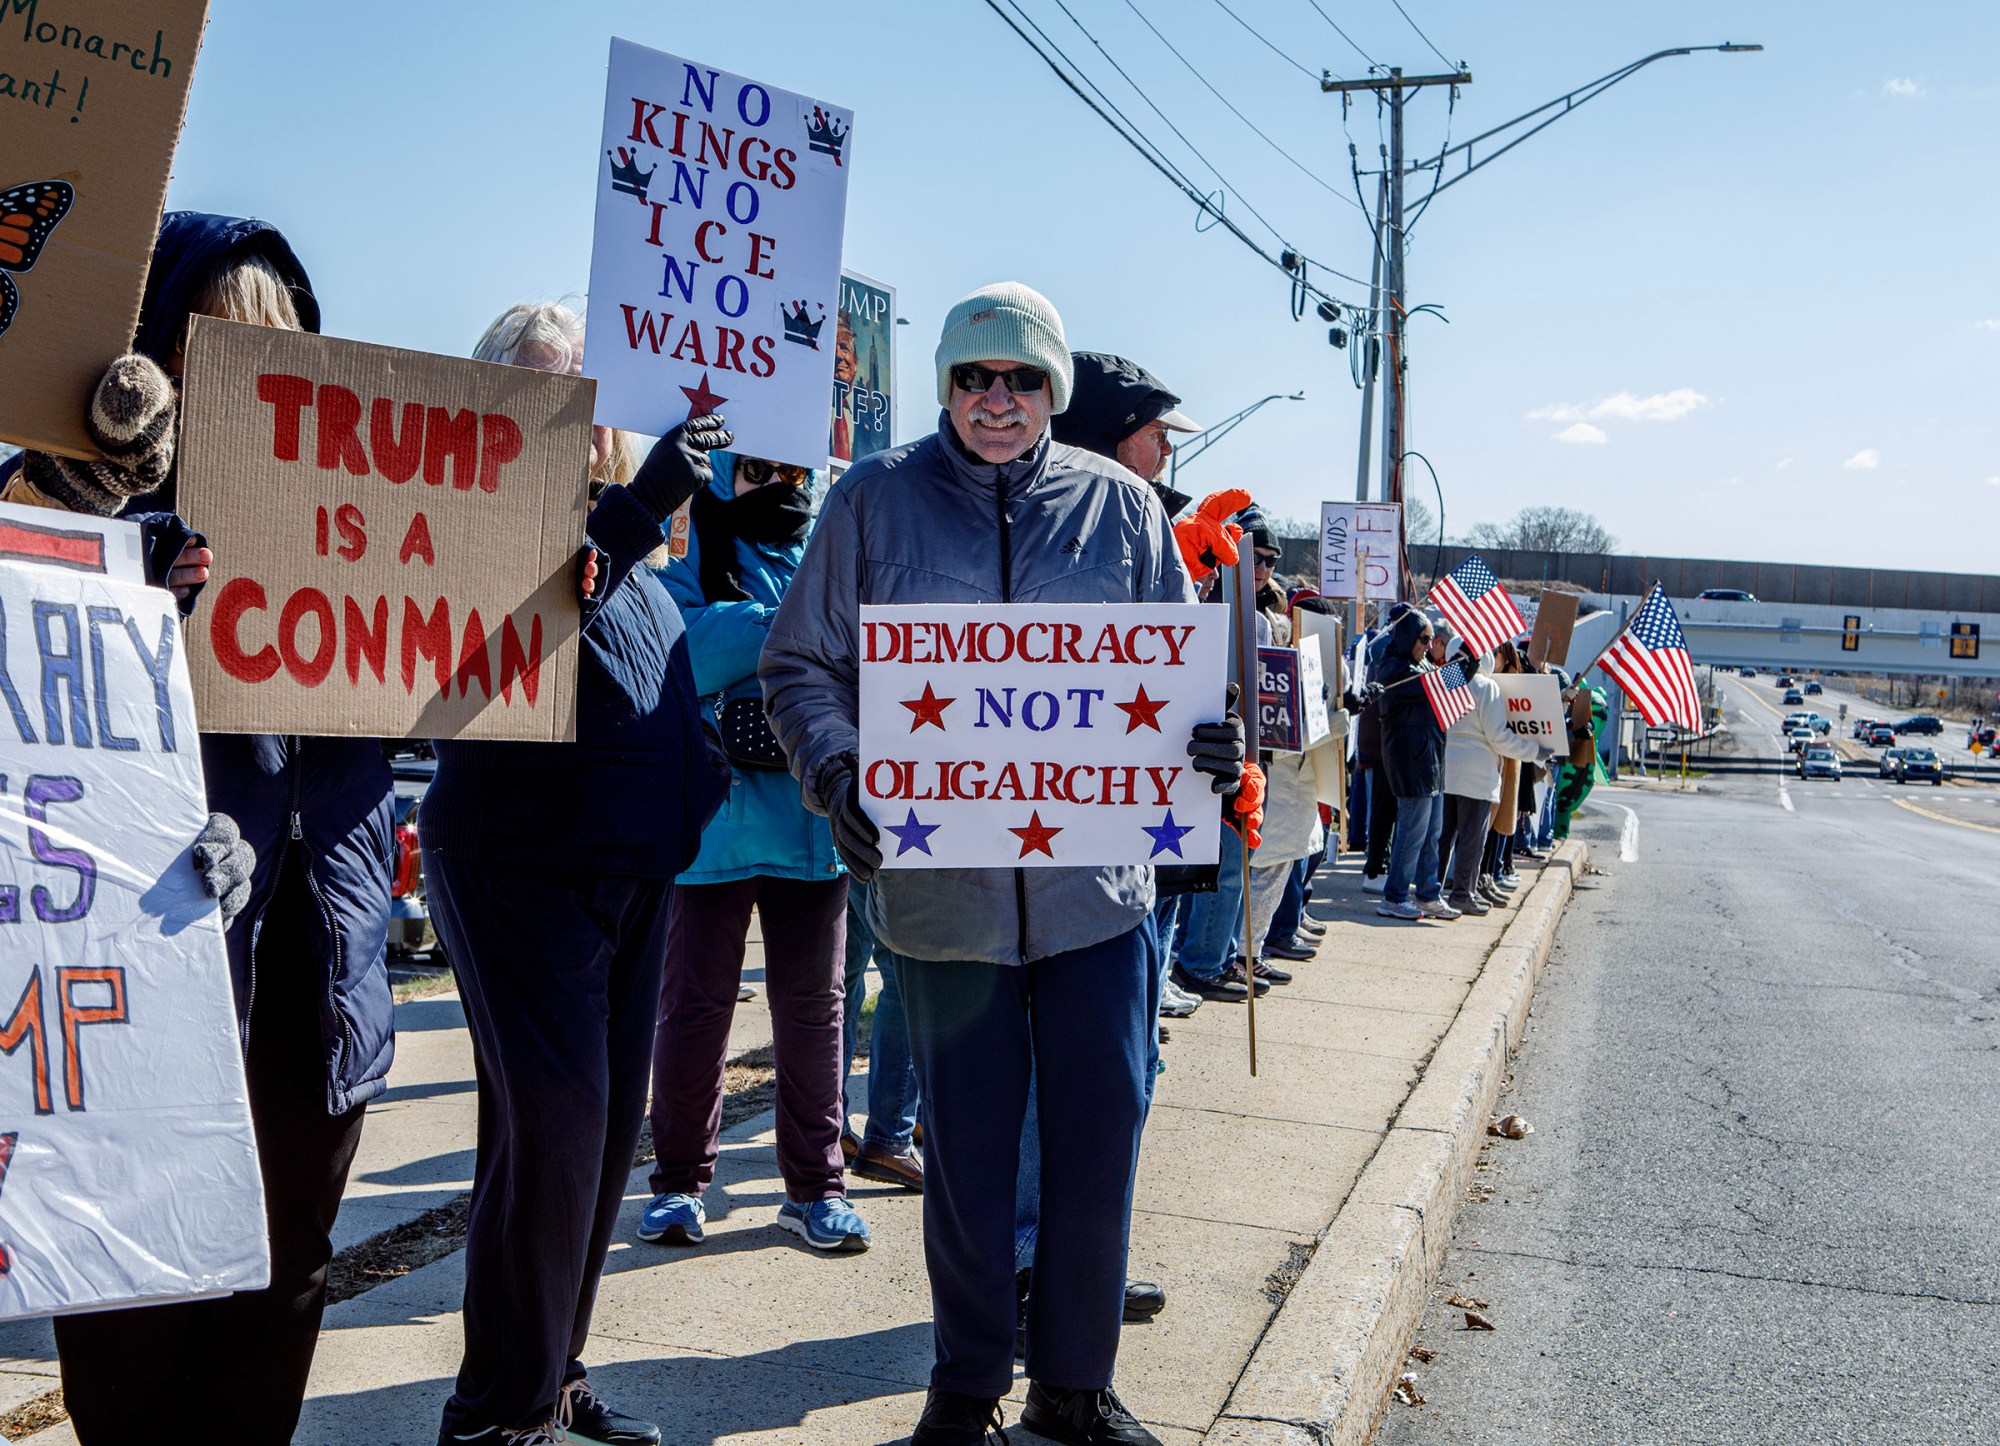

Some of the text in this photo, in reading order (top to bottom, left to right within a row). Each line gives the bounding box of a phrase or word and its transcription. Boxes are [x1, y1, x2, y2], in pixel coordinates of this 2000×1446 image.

[0, 0, 172, 77] Monarch
[680, 63, 771, 127] NO
[627, 97, 797, 190] KINGS
[668, 160, 760, 225] NO
[645, 200, 776, 280] ICE
[658, 253, 750, 318] NO
[619, 303, 776, 378] WARS
[257, 373, 523, 494] TRUMP
[315, 503, 435, 567] IS A
[1325, 507, 1396, 587] HANDS OFF!
[210, 577, 543, 710] CONMAN
[861, 621, 1197, 667] DEMOCRACY
[973, 687, 1105, 733] NOT
[1507, 697, 1532, 712] NO
[865, 758, 1183, 806] OLIGARCHY
